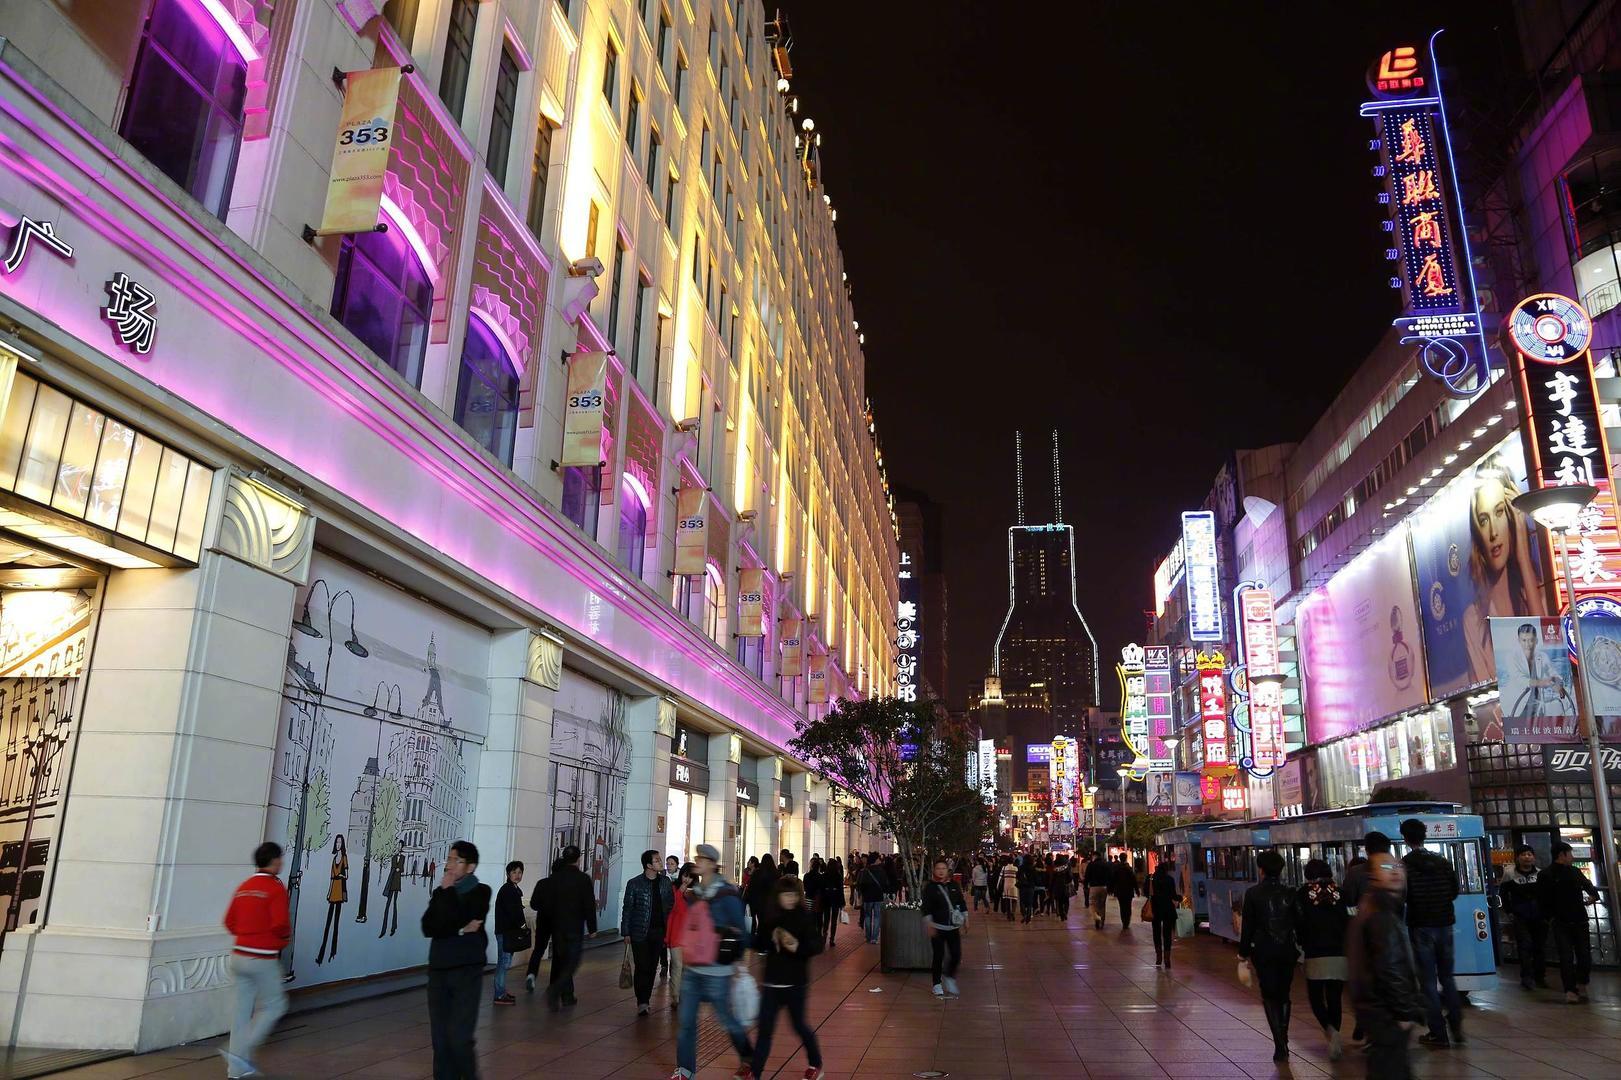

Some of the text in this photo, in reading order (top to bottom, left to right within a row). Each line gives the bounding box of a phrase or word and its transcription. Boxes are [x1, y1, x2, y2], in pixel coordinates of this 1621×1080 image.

[346, 119, 372, 127] PLAZA
[340, 127, 388, 145] 353
[5, 215, 157, 354] 广场
[1407, 321, 1476, 331] COMMERCIAL
[569, 395, 602, 408] 353
[680, 520, 704, 529] 353
[741, 594, 761, 602] 353
[1223, 788, 1242, 799] UNI
[1223, 799, 1245, 811] QLO
[1424, 823, 1455, 833] 光车
